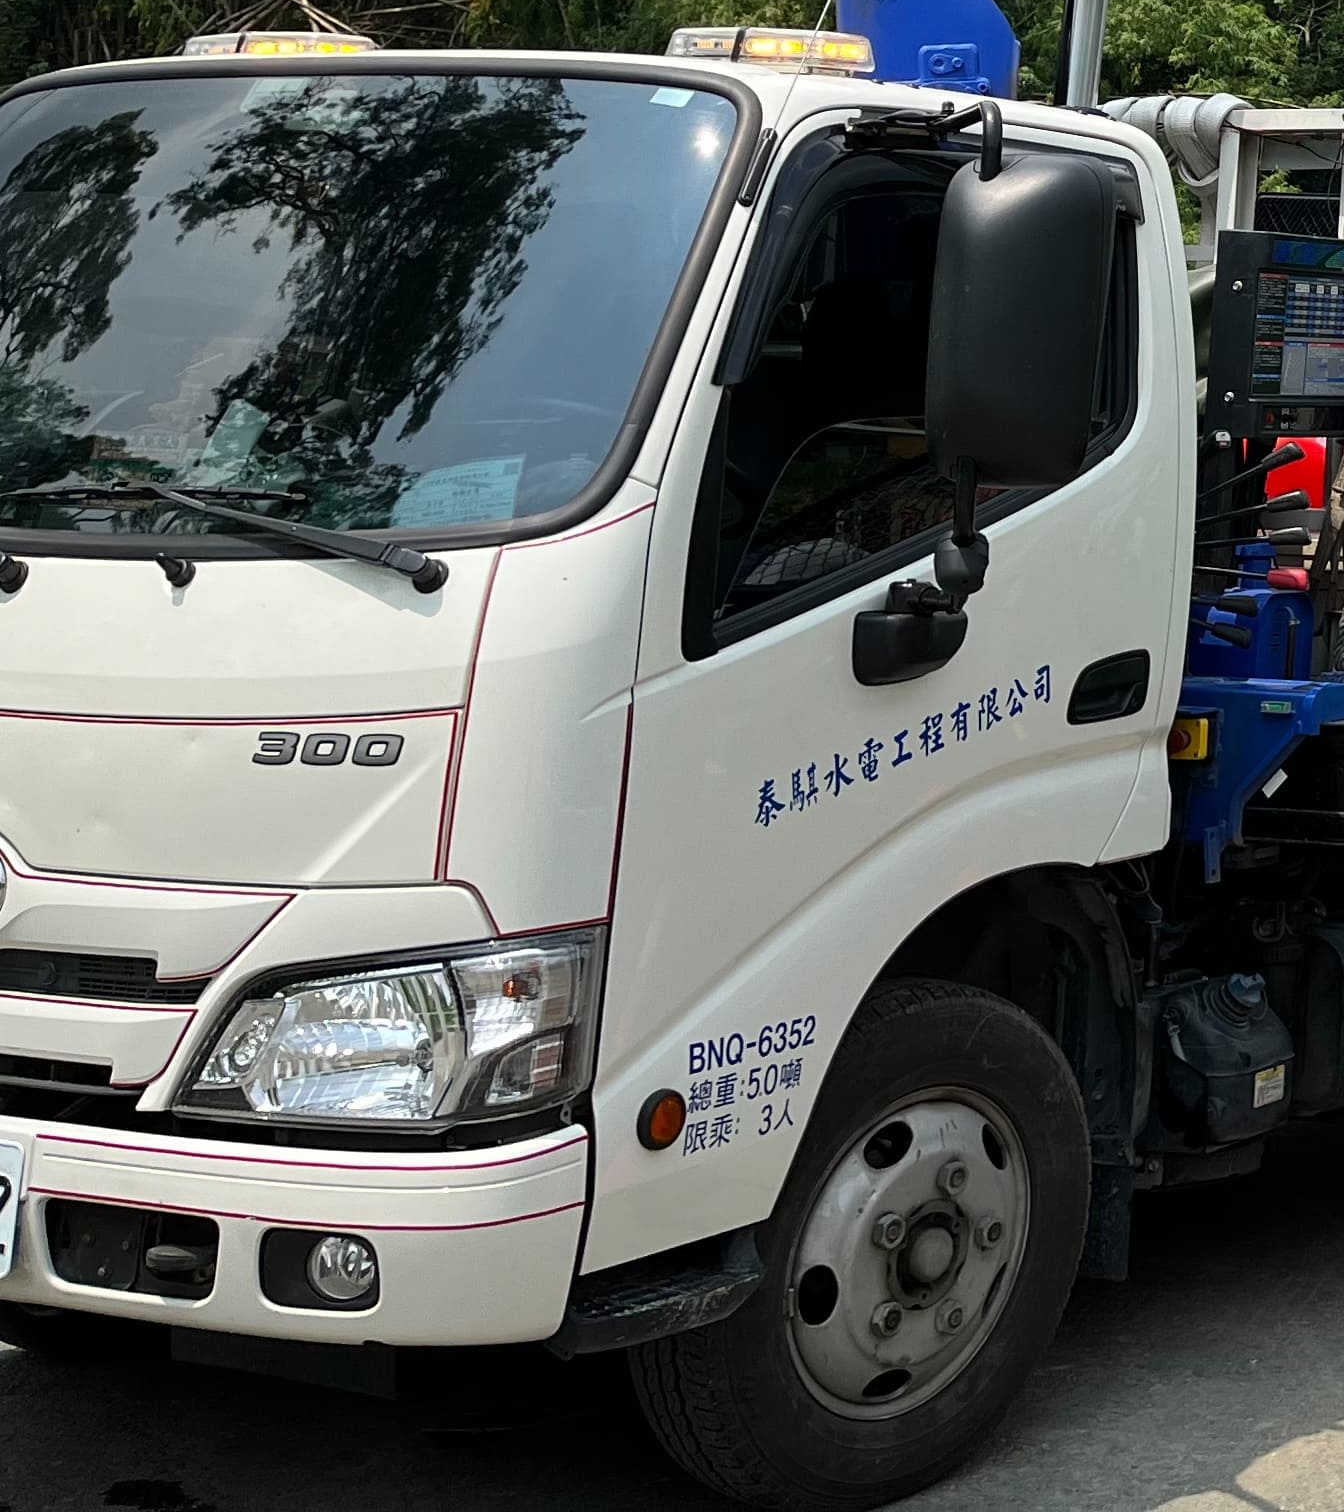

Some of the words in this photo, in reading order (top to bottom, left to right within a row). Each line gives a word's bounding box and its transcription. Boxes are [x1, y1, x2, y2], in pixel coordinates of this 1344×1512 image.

[251, 731, 405, 767] 300
[754, 664, 1051, 827] 泰騏水電工程有限公司
[689, 1015, 816, 1075] BNQ-6352
